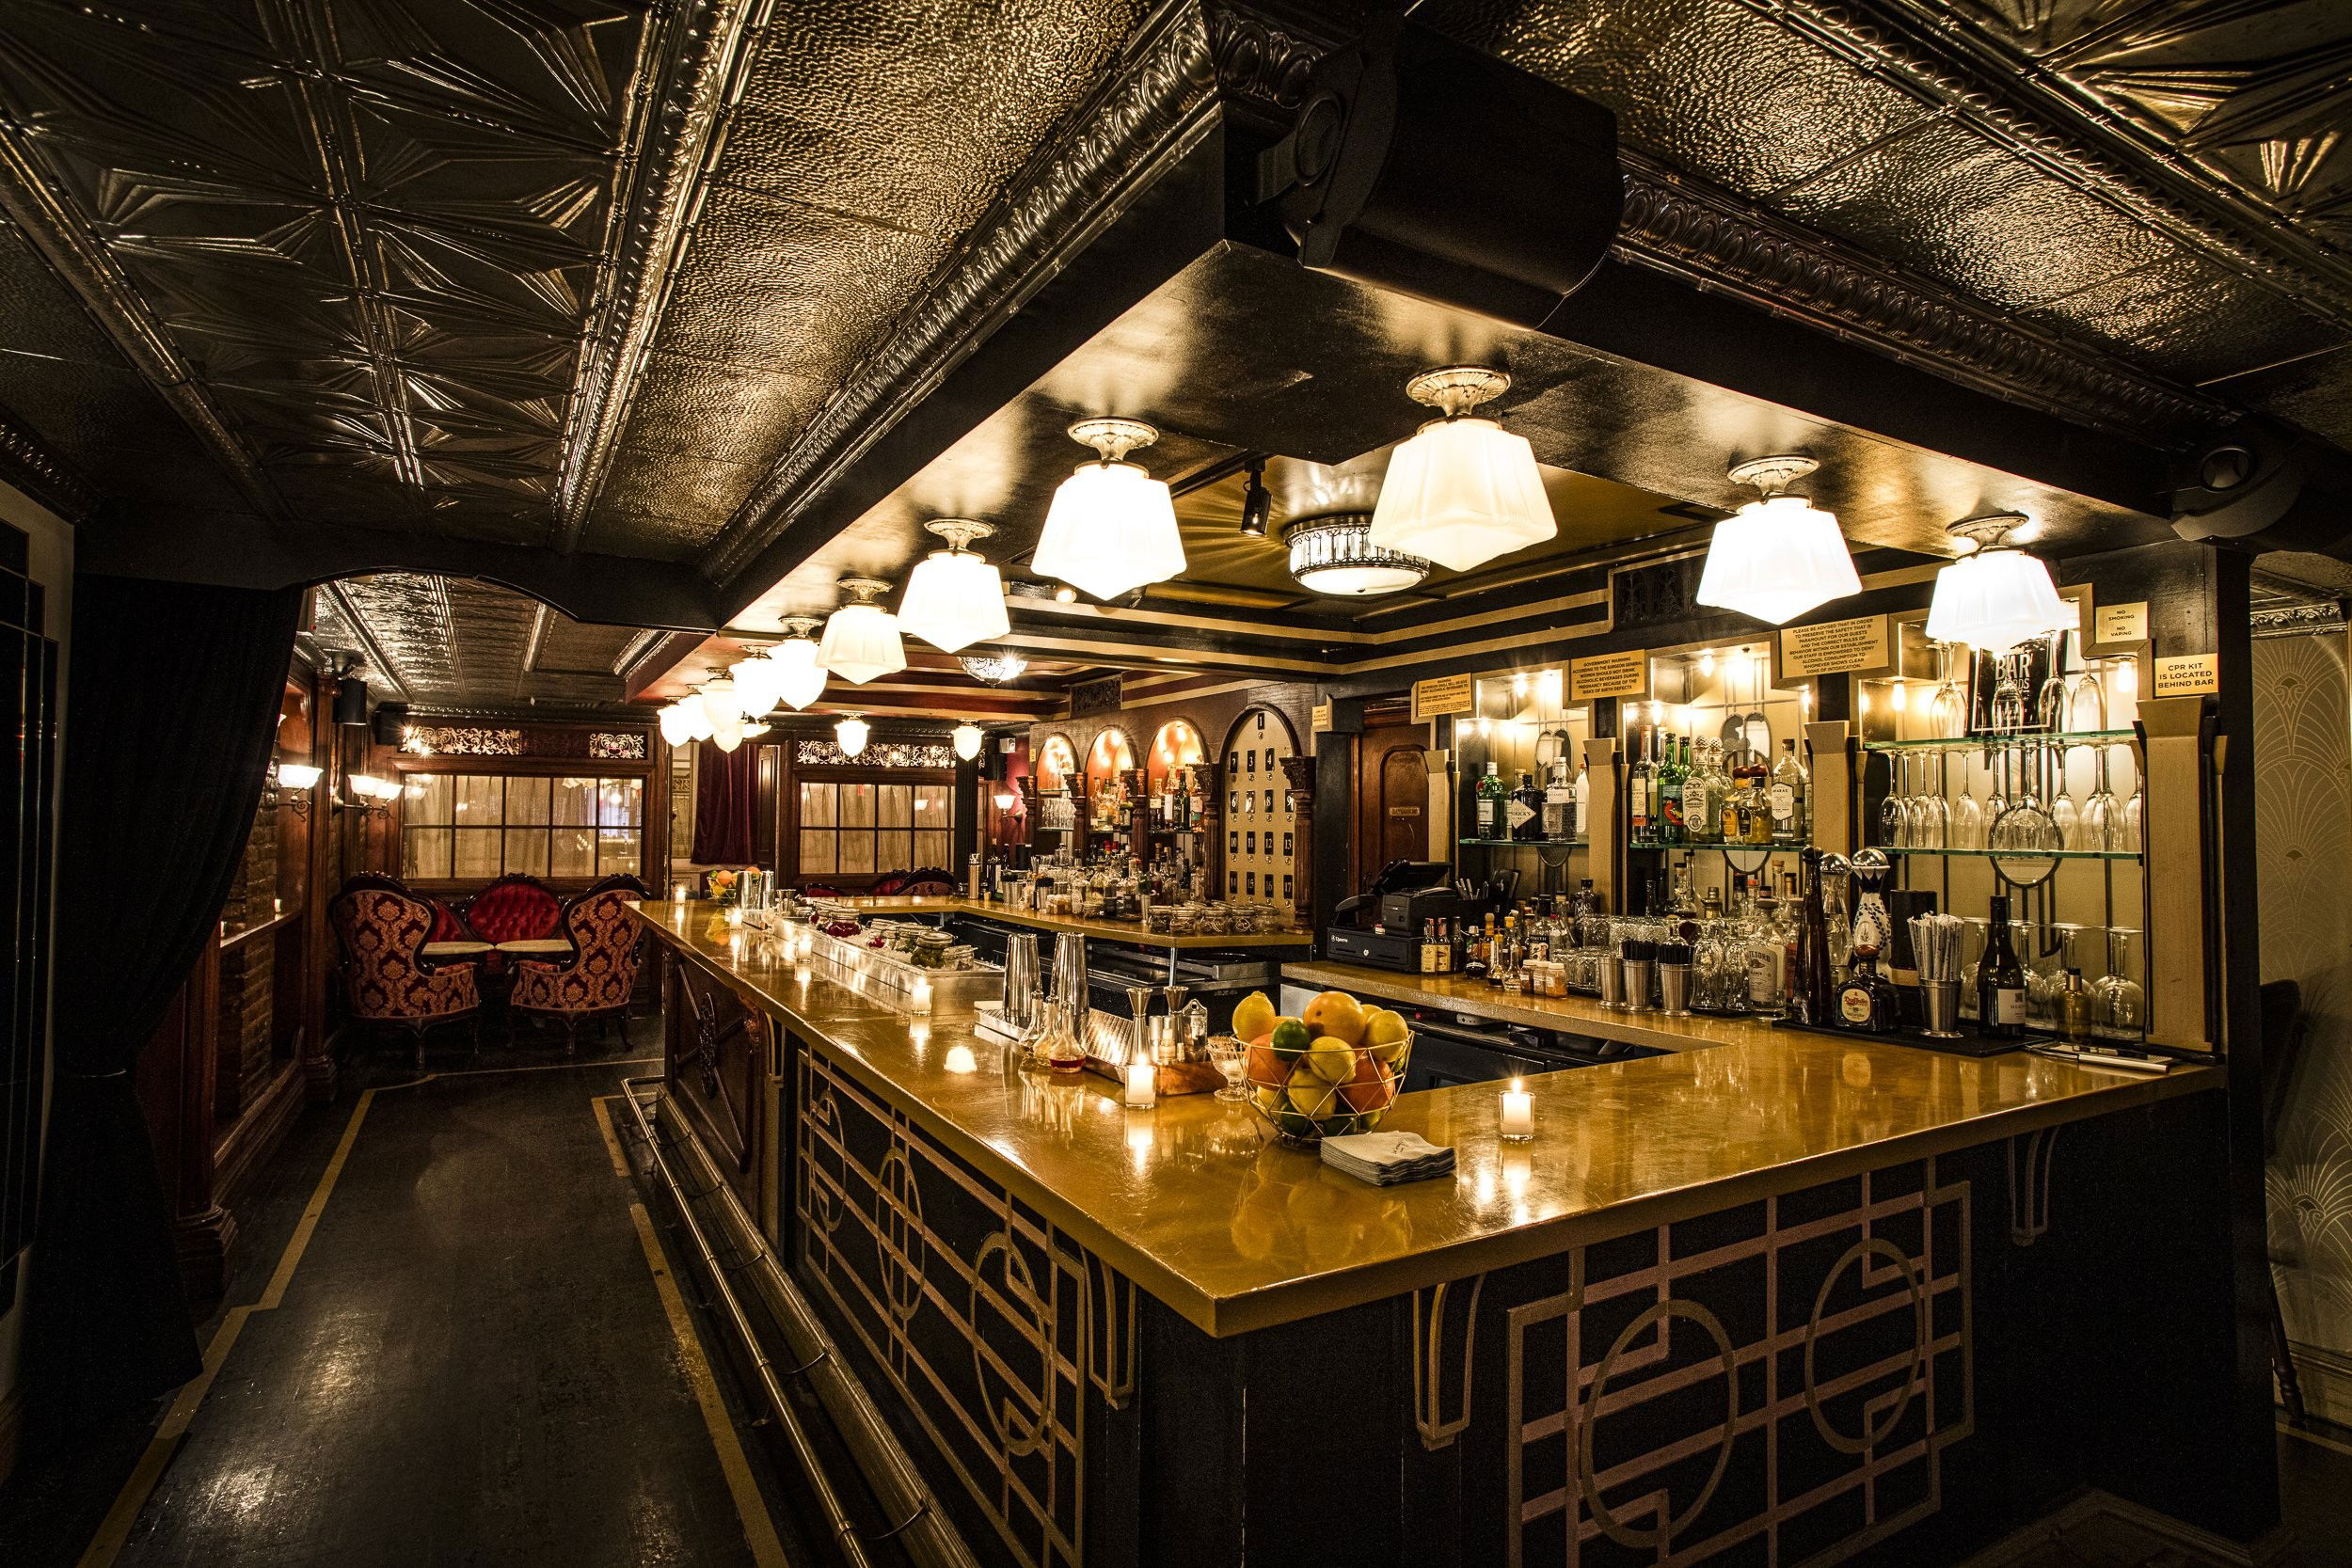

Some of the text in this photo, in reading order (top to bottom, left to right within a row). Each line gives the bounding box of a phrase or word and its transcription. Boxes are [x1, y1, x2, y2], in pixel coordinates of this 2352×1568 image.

[1841, 640, 1878, 648] ESTABLISHMENT
[1995, 654, 2030, 681] BAR
[2170, 671, 2212, 679] LOCATED
[2158, 680, 2192, 689] BEHIND
[1232, 798, 1236, 807] 6
[1266, 797, 1271, 806] 8
[1231, 837, 1236, 847] 10
[1248, 838, 1253, 847] 11
[1265, 838, 1272, 848] 12
[1285, 839, 1292, 849] 13
[1248, 879, 1254, 889] 15
[1285, 882, 1292, 892] 17
